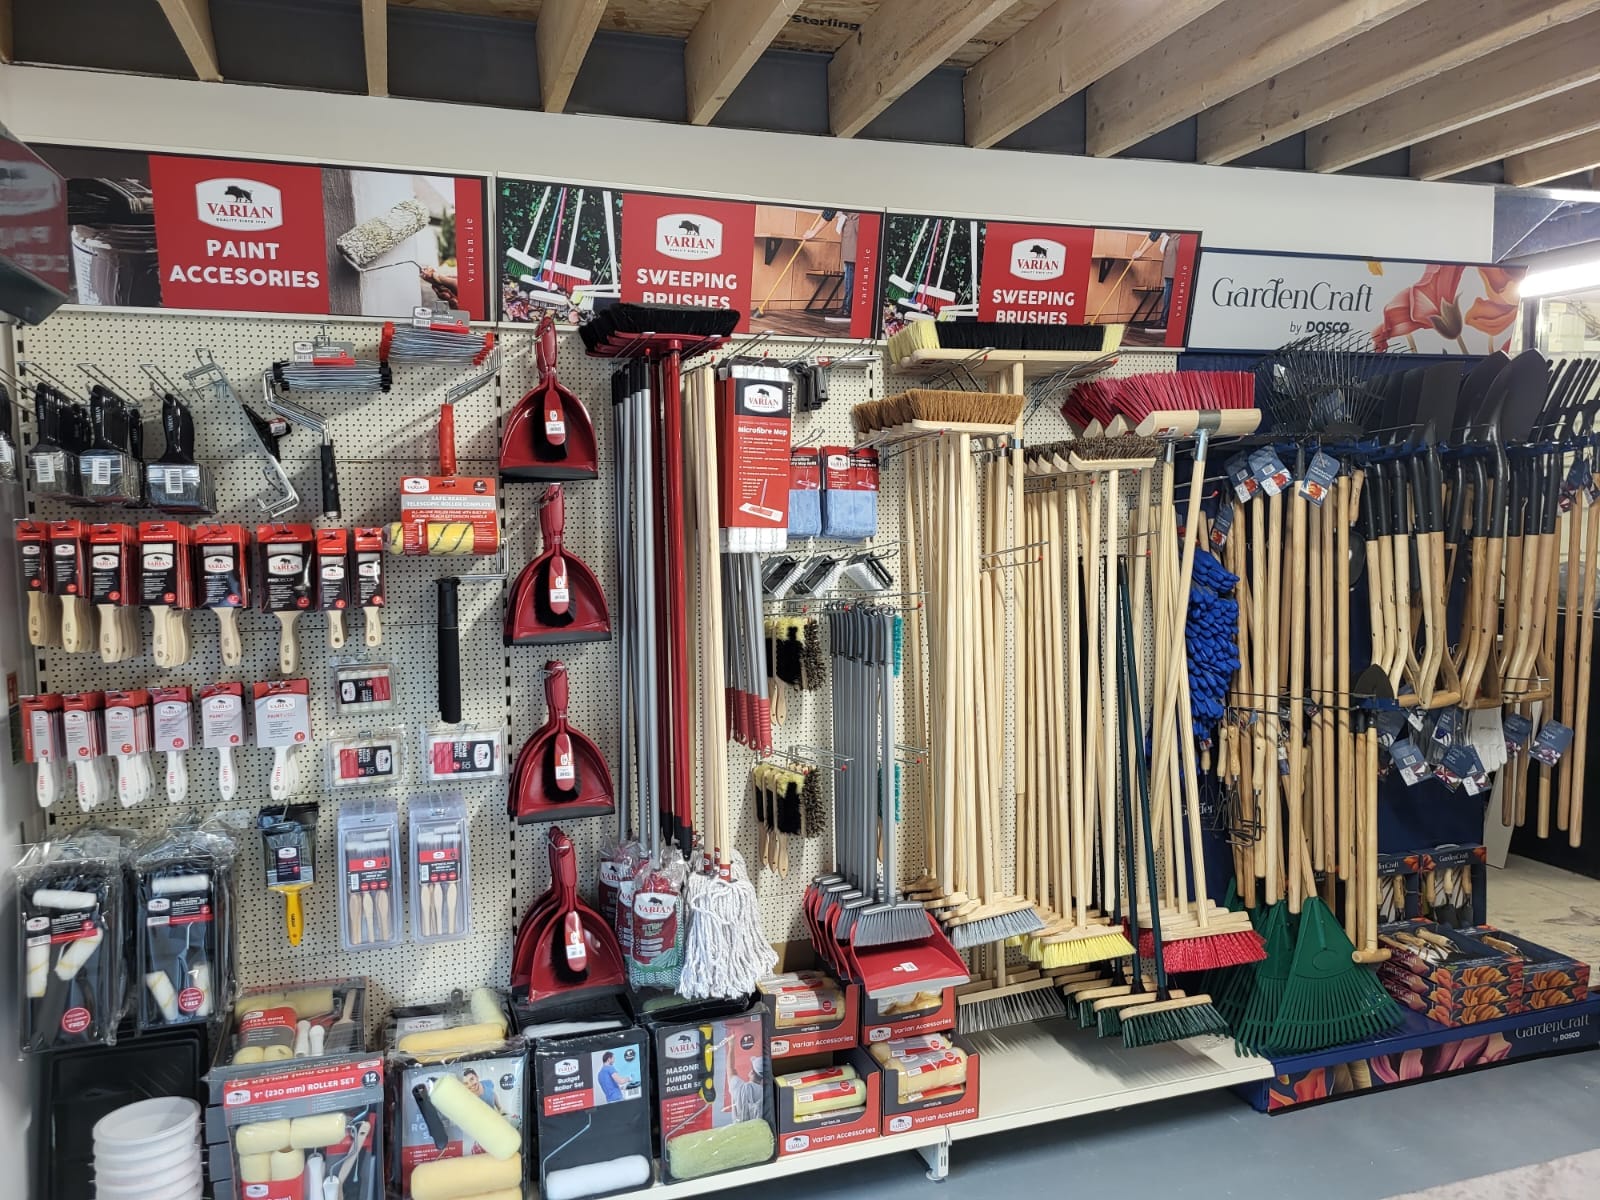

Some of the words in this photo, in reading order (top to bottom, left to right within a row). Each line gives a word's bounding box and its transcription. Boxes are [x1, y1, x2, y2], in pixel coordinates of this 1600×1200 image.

[792, 14, 860, 31] Sterling
[206, 202, 274, 218] VARIAN
[664, 235, 715, 249] VARIAN
[206, 240, 280, 260] PAINT
[464, 218, 474, 282] varian.ie
[1017, 259, 1059, 270] VARIAN
[169, 264, 320, 288] ACCESORIES
[636, 268, 737, 290] SWEEPING
[861, 249, 870, 304] varian.ie
[992, 289, 1075, 306] SWEEPING
[1176, 266, 1188, 317] varian.ie
[1212, 277, 1374, 312] GardenCraft
[642, 291, 730, 309] BRUSHES
[996, 310, 1068, 325] BRUSHES
[1289, 321, 1302, 335] by
[1306, 321, 1350, 334] DOSCO
[749, 397, 778, 406] VARIAN
[738, 426, 772, 434] Microfibre
[639, 905, 672, 913] VARIAN
[916, 1019, 952, 1030] Accessories
[1515, 1013, 1590, 1039] GardenCraft
[815, 1035, 854, 1045] Accessories
[1560, 1031, 1580, 1040] DOSCO
[670, 1043, 699, 1054] VARIAN
[665, 1064, 699, 1075] MASONR
[365, 1073, 376, 1082] 12
[557, 1075, 580, 1084] Budget
[666, 1074, 693, 1085] JUMBO
[265, 1088, 284, 1099] (230
[286, 1084, 305, 1094] mm)
[308, 1080, 338, 1091] ROLLER
[340, 1077, 356, 1086] SET
[666, 1082, 692, 1092] ROLLER
[915, 1115, 936, 1123] Varian
[938, 1108, 975, 1119] Accessories
[812, 1135, 834, 1143] Varian
[836, 1127, 876, 1139] Accessories
